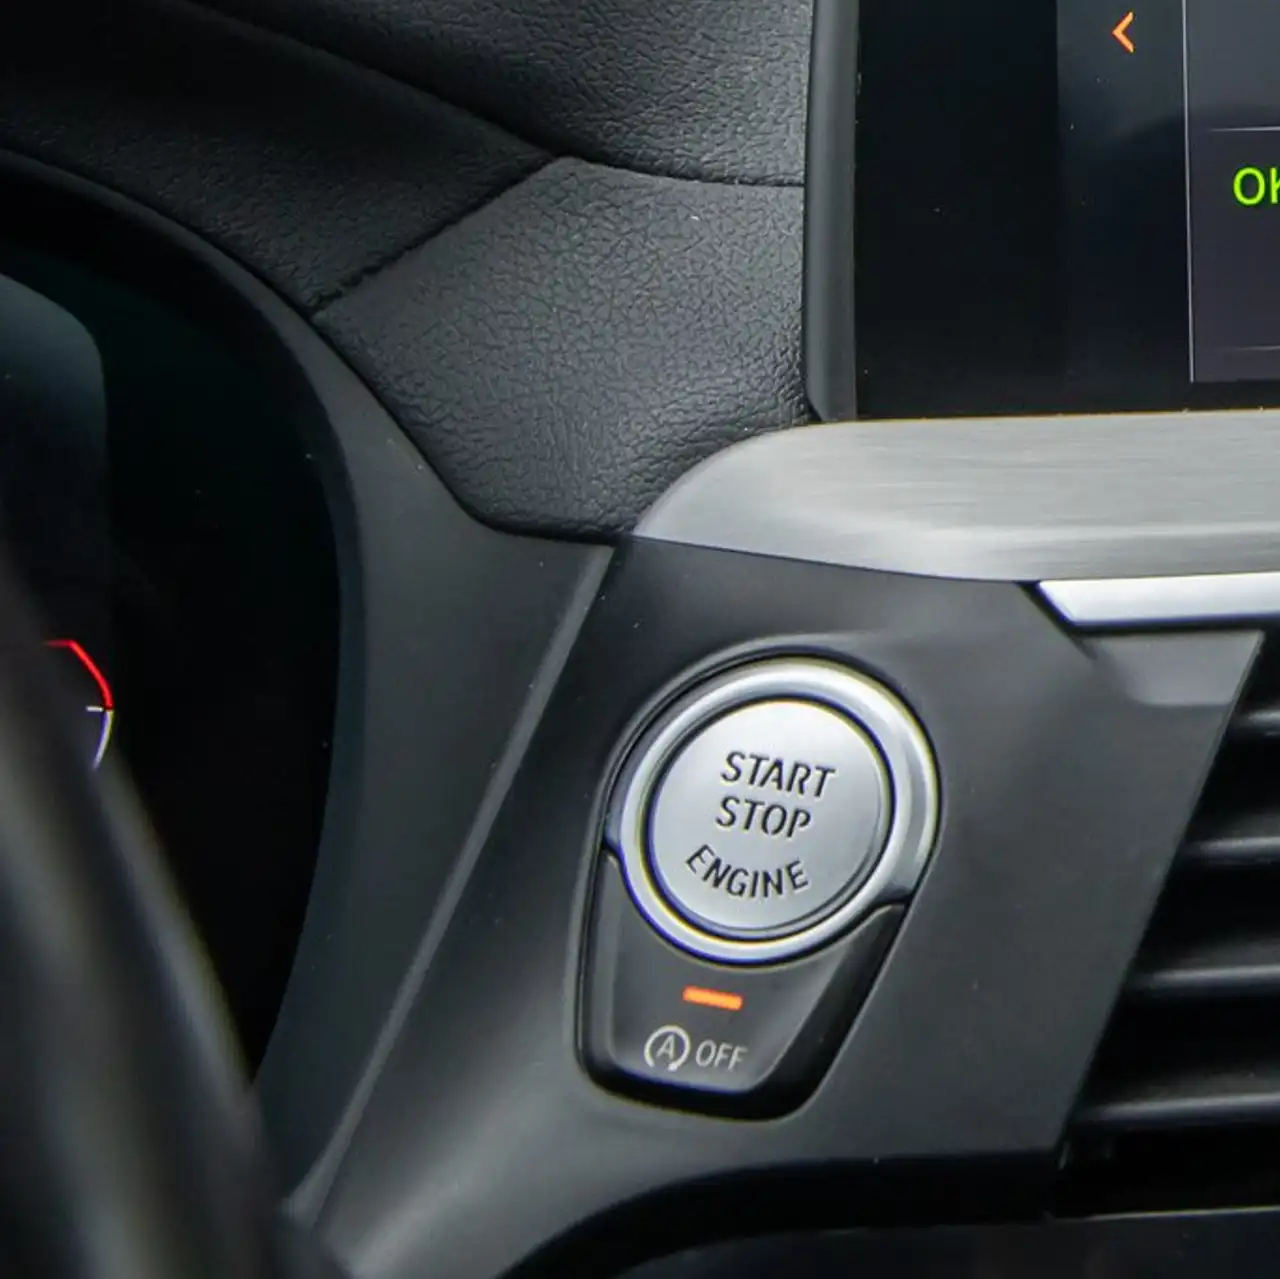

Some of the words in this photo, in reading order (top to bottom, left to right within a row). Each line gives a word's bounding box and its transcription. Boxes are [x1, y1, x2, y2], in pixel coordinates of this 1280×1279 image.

[720, 750, 835, 799] START
[716, 795, 811, 839] STOP
[685, 843, 809, 899] ENGINE
[695, 1040, 748, 1070] OFF
